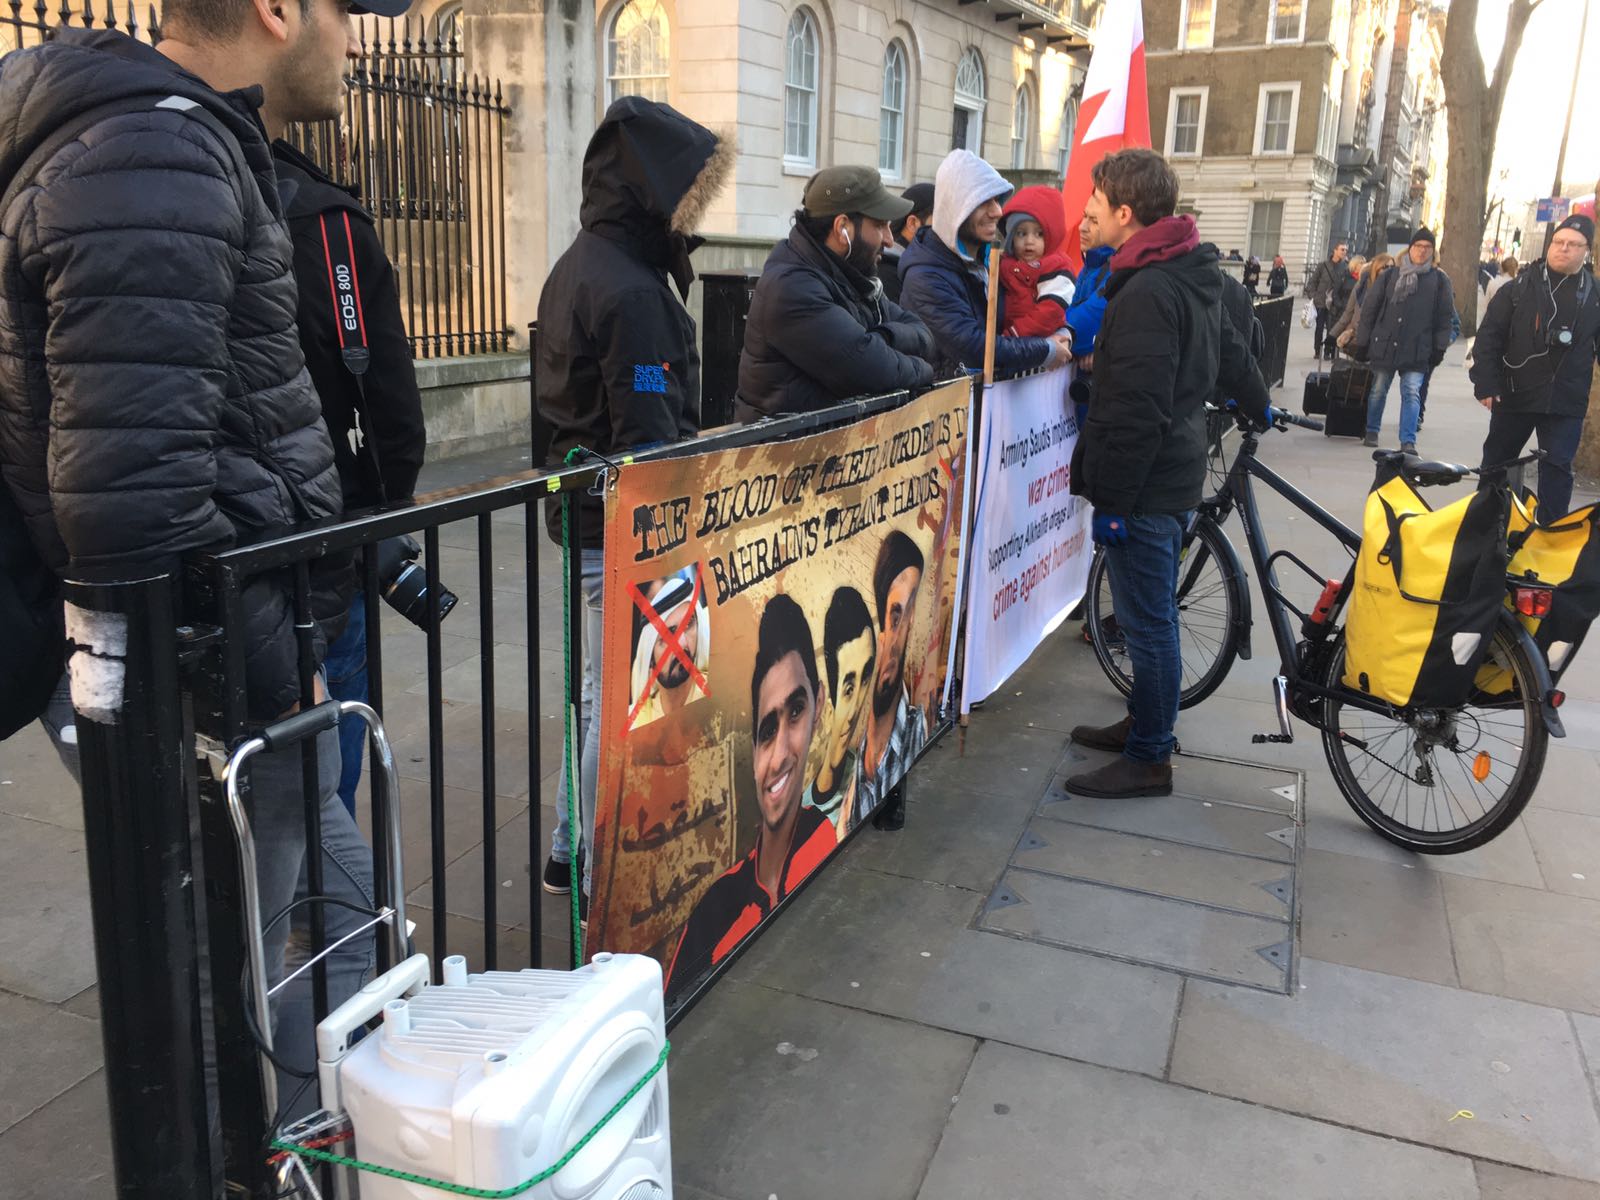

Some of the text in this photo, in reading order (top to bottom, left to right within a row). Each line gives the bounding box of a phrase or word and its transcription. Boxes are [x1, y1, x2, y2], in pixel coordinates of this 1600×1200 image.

[336, 264, 358, 331] EOS 80D
[999, 432, 1029, 472] Arming
[1029, 422, 1051, 457] Saudis
[633, 496, 691, 562] THE
[696, 474, 778, 539] BLOOD
[782, 463, 818, 506] OF
[936, 412, 951, 447] IS
[824, 485, 890, 549] TYRANT
[892, 466, 940, 517] HANDS
[1028, 475, 1047, 508] war
[993, 577, 1018, 622] crime
[1020, 551, 1052, 602] against
[621, 787, 728, 853] يسقط
[630, 860, 717, 928] حمد
